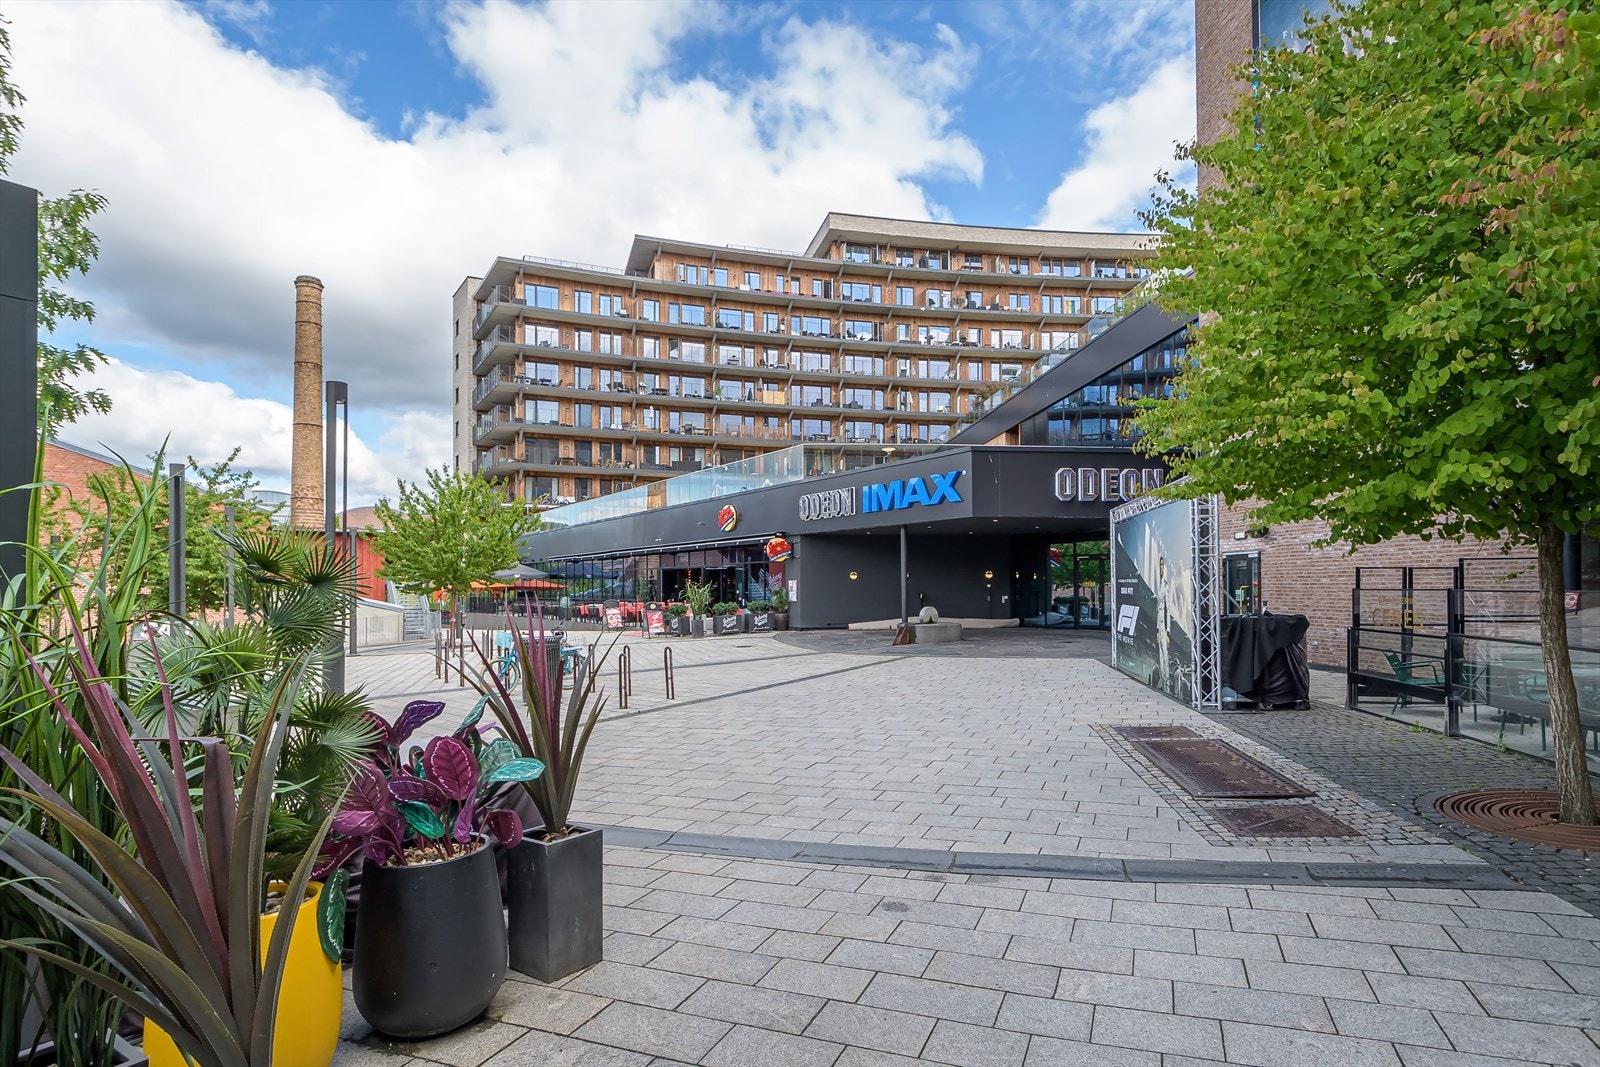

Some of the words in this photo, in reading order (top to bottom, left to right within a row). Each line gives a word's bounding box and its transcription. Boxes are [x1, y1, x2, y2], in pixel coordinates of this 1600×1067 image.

[799, 487, 856, 521] ODEON
[862, 470, 961, 513] IMAX
[1055, 467, 1164, 502] ODEON
[1372, 608, 1424, 630] CERES
